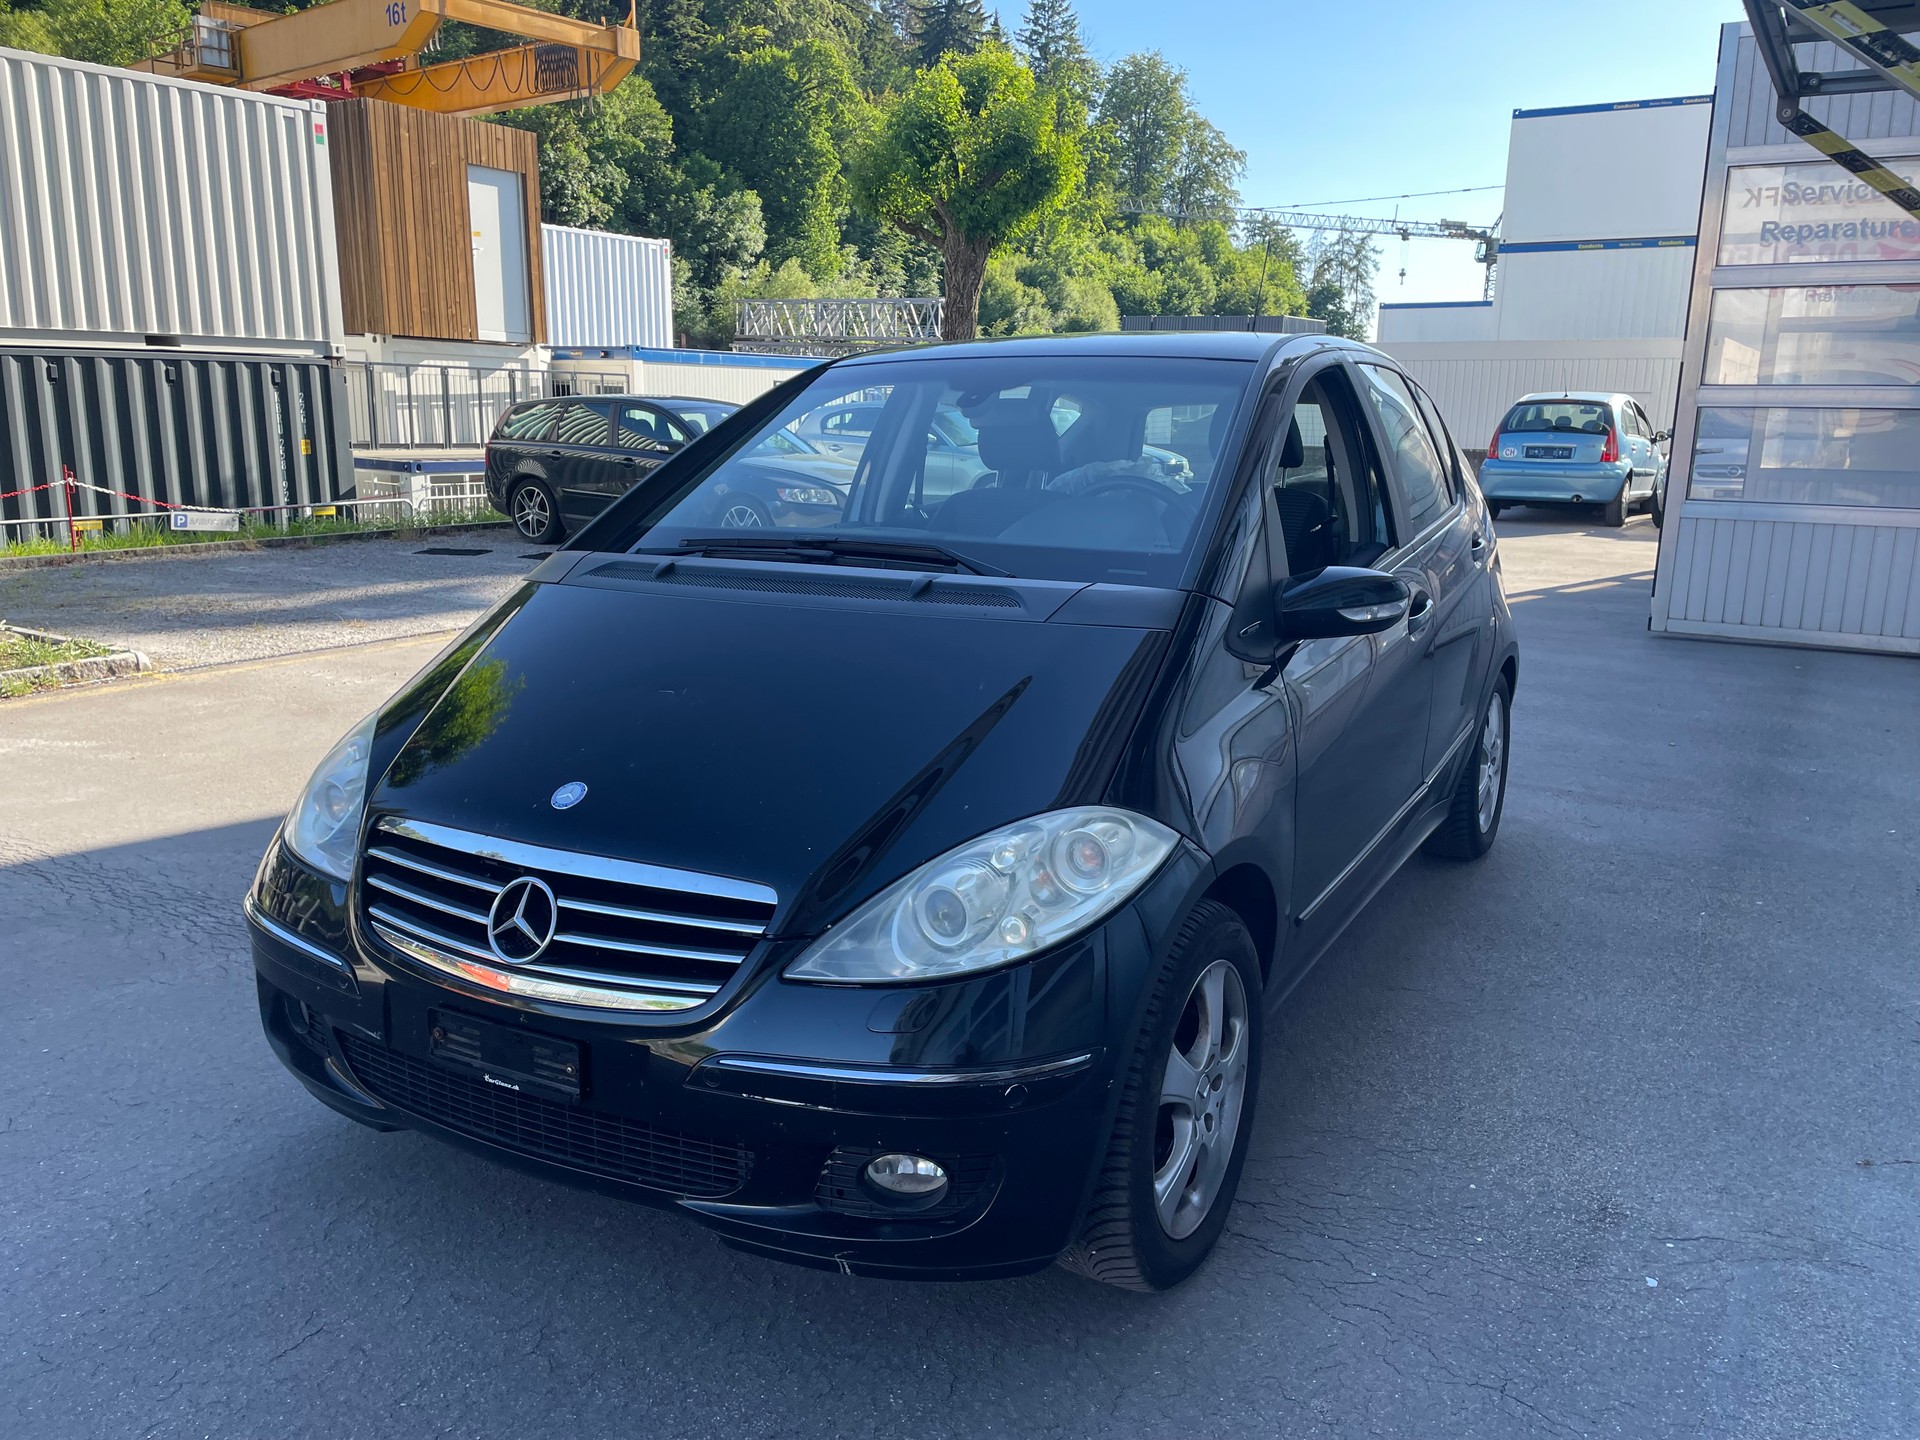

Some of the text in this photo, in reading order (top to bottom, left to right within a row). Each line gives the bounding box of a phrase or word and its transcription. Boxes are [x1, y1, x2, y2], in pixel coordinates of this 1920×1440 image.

[385, 1, 407, 27] 16t
[1759, 217, 1920, 245] Reparature
[1505, 449, 1515, 457] CH
